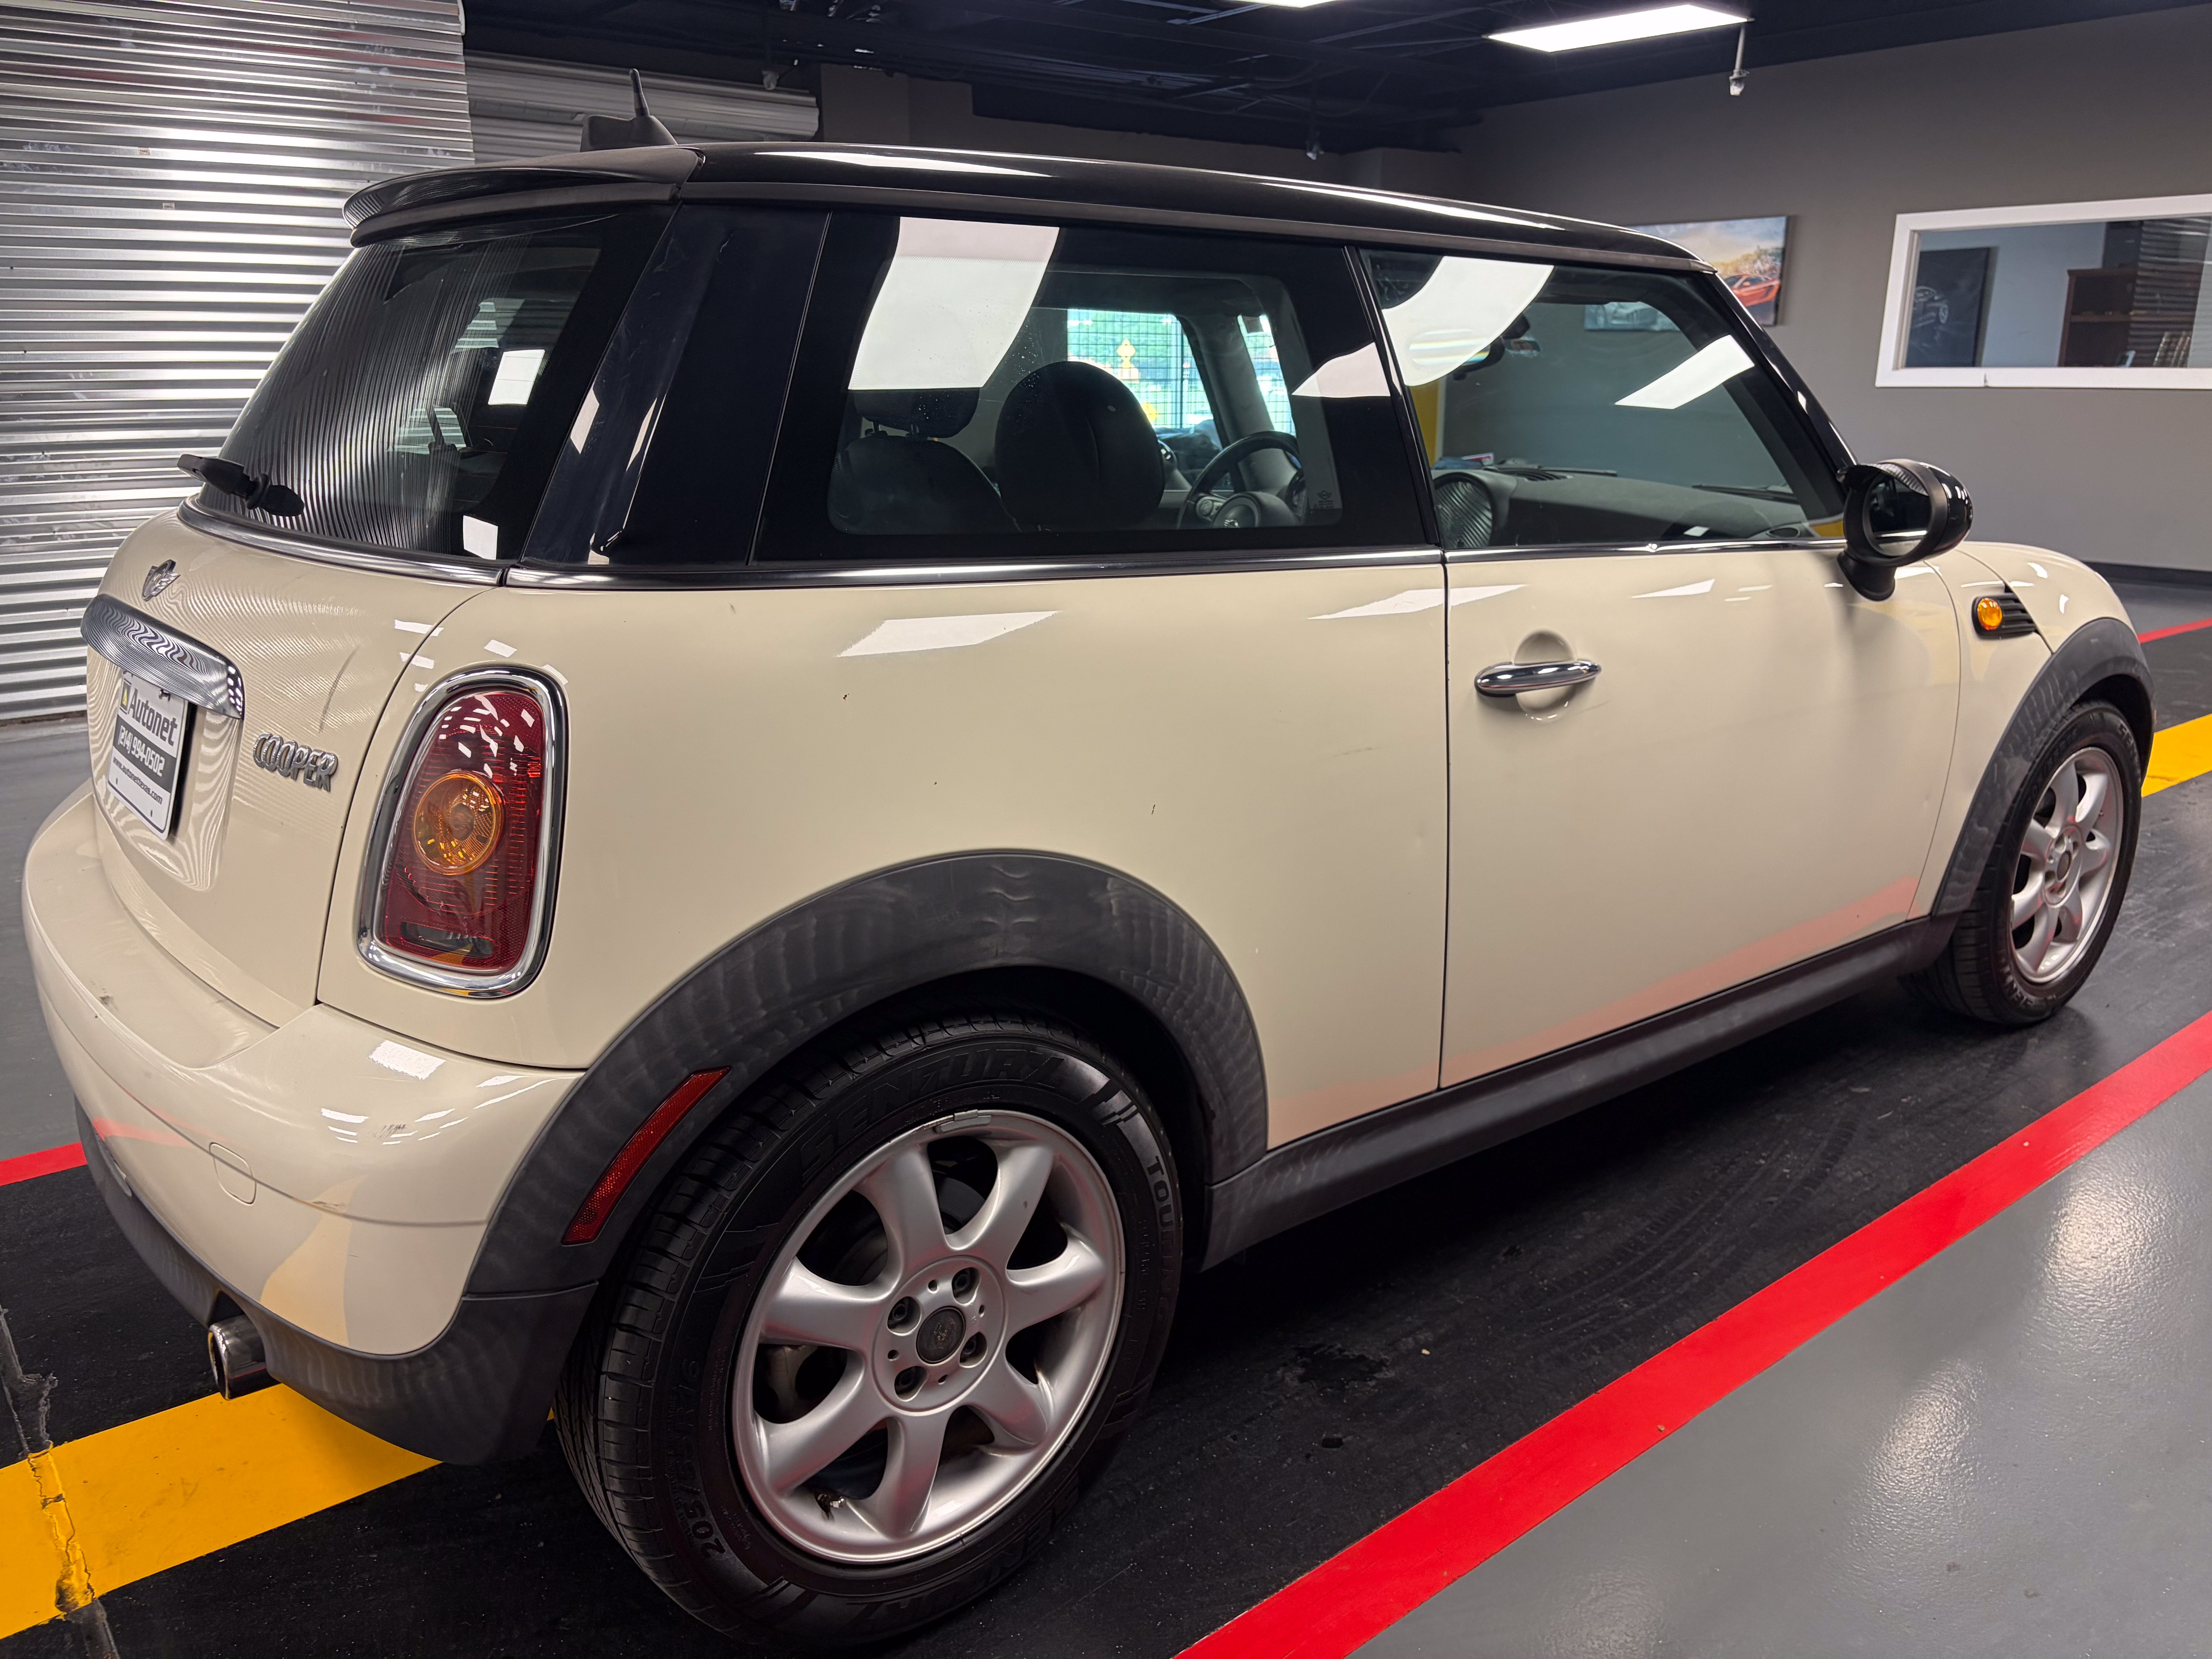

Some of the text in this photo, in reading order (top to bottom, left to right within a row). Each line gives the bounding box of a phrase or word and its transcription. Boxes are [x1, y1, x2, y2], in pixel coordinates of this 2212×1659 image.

[128, 688, 178, 746] Autonet
[118, 725, 165, 777] (214) 994-0502
[253, 732, 338, 792] COOPER
